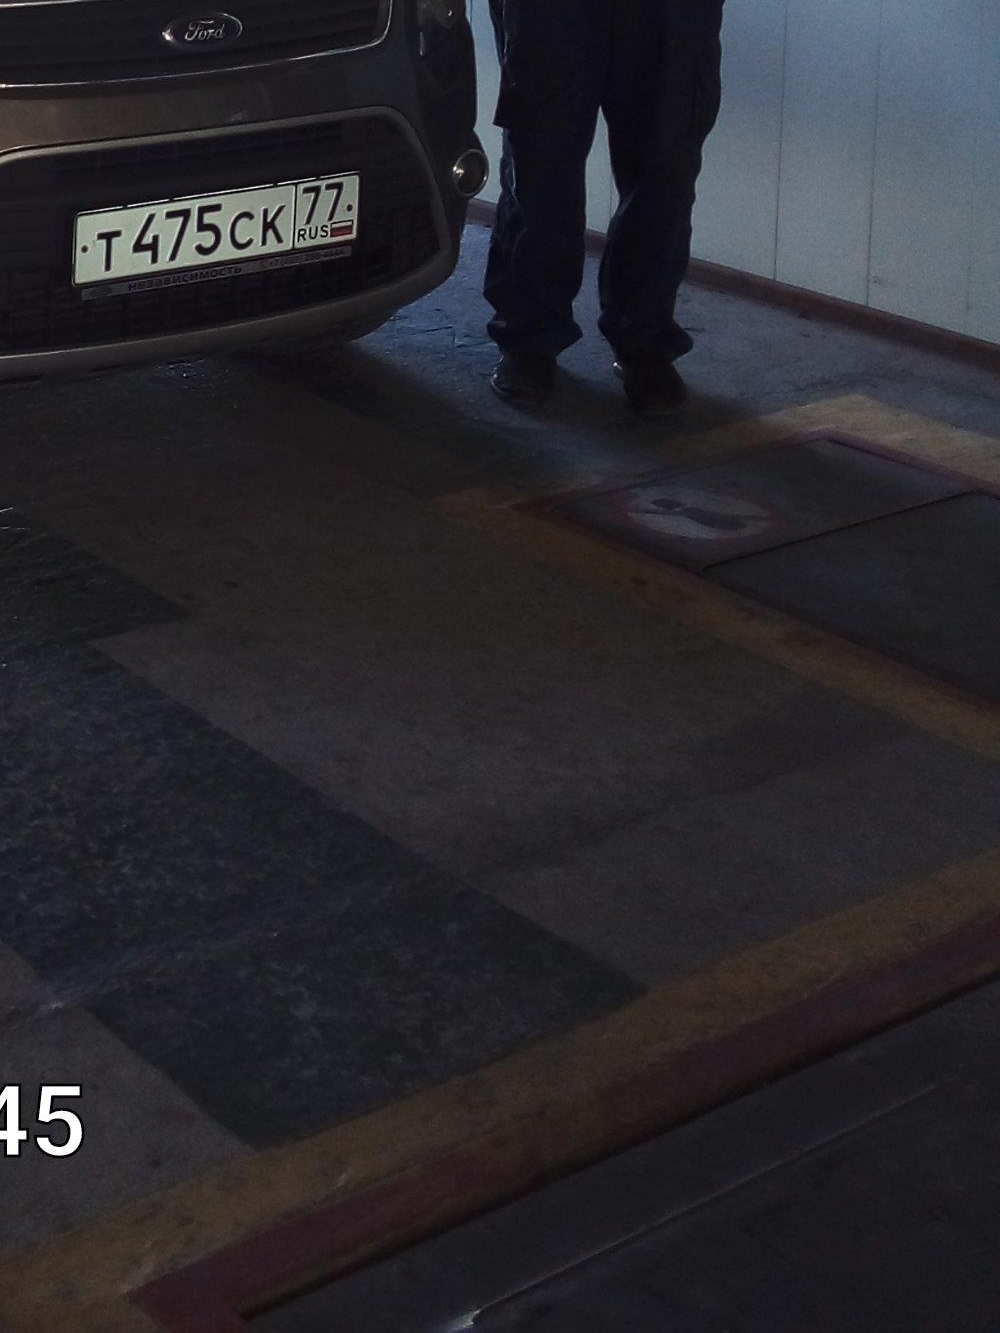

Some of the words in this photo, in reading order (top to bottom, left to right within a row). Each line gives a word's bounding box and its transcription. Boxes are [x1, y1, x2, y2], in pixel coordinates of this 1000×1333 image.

[184, 20, 225, 41] Ford
[96, 202, 287, 273] Т475СК
[301, 181, 345, 226] 77
[296, 223, 329, 243] RUS
